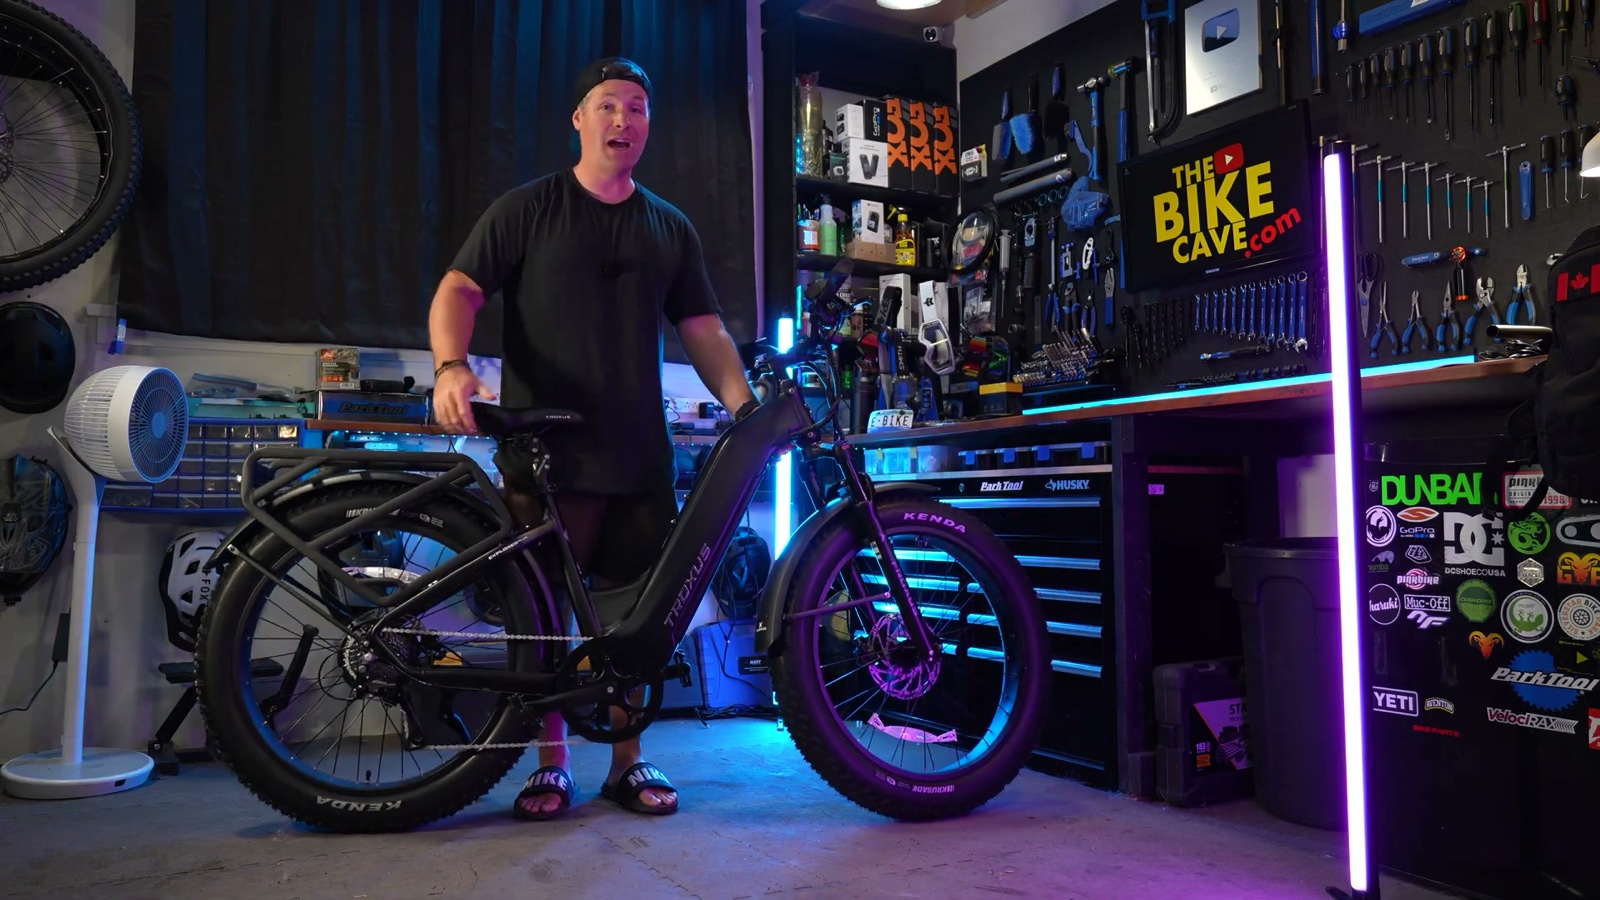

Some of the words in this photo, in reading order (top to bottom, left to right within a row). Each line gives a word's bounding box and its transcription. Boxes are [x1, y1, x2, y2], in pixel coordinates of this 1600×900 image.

[886, 98, 909, 168] FOX
[910, 102, 933, 172] FOX
[932, 105, 957, 175] FOX
[1172, 155, 1215, 189] THE
[1153, 160, 1275, 244] BIKE
[1172, 220, 1248, 264] CAVE
[1244, 207, 1302, 258] .com
[897, 345, 906, 371] SMITH
[870, 415, 909, 428] E-BIKE
[1056, 479, 1089, 490] HUSKY
[902, 511, 967, 533] KENDA
[1399, 526, 1435, 534] GoPro
[199, 579, 211, 601] FOX
[664, 542, 711, 627] TROXUS
[1396, 575, 1440, 585] pinkbike
[1406, 596, 1449, 610] Muc-Off
[1584, 599, 1599, 615] BIKE
[1229, 703, 1248, 715] STA
[1373, 691, 1414, 711] YETI
[1426, 699, 1453, 712] AVENTON
[1486, 707, 1559, 730] VelociRAX
[1412, 724, 1431, 733] BIKE
[1431, 727, 1460, 737] PARTS
[522, 771, 568, 792] NIKE
[316, 794, 403, 812] KENDA
